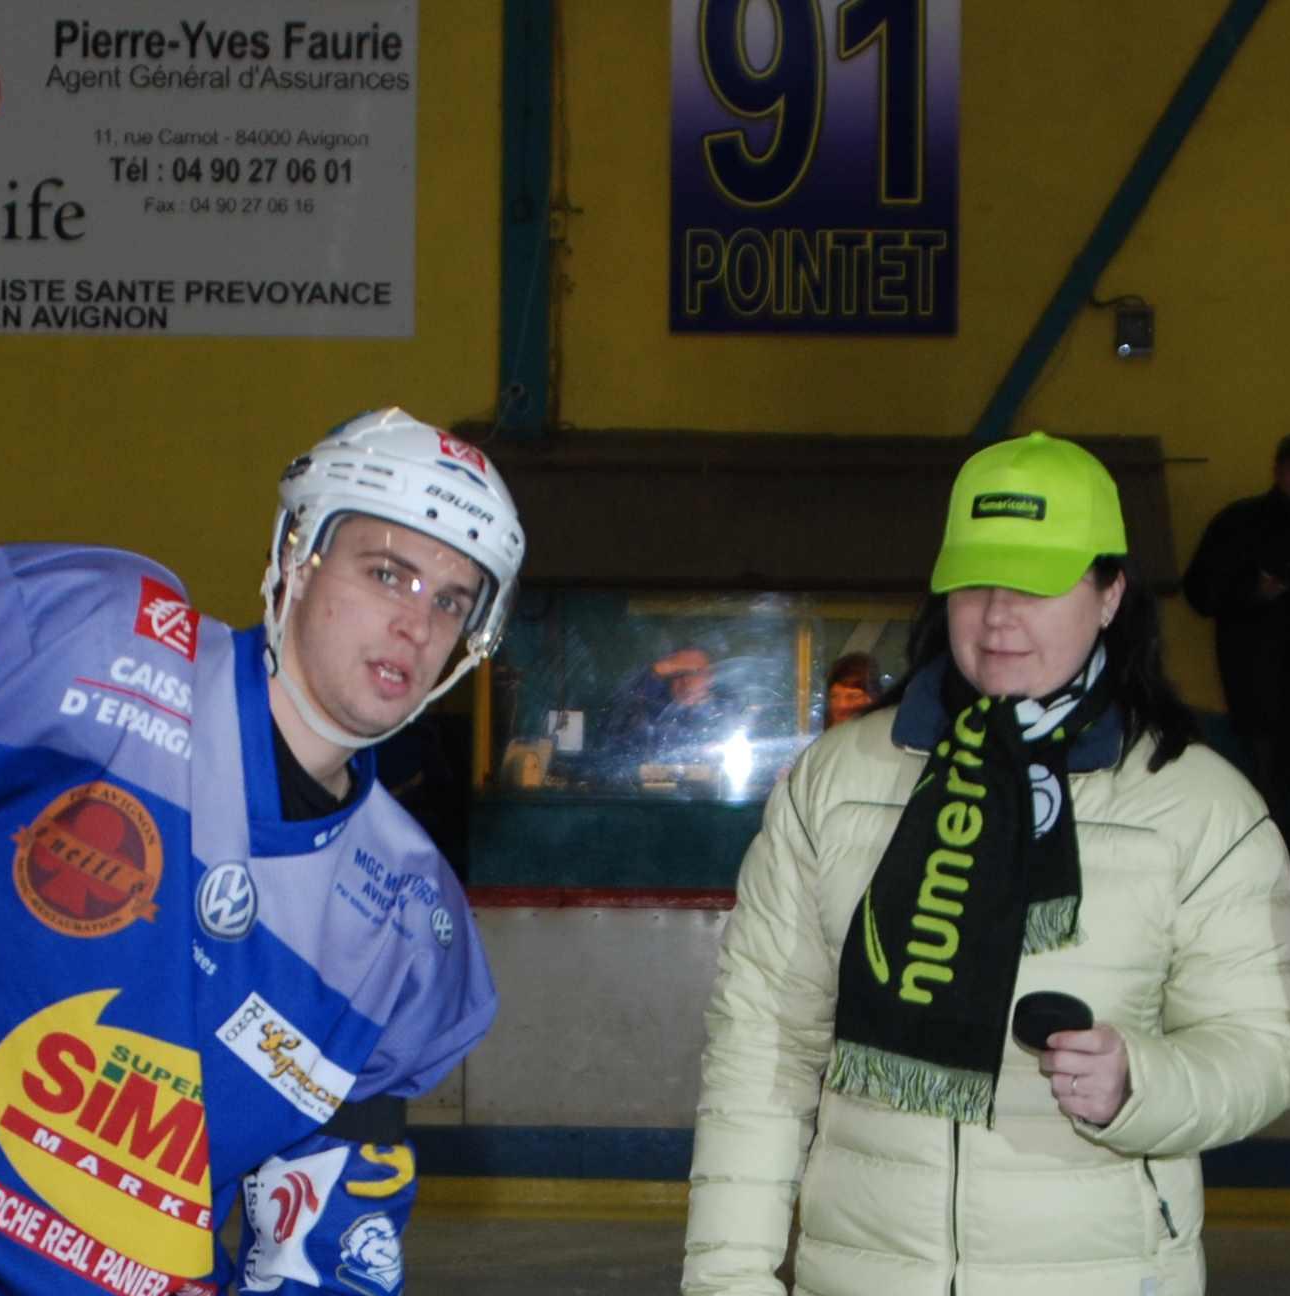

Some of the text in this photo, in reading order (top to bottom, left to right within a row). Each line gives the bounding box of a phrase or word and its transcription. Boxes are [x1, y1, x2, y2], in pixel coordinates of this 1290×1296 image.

[54, 19, 403, 61] Pierre-Yves Faurie
[45, 63, 411, 94] Agent Général d'Assurances
[698, 0, 926, 208] 91
[124, 131, 154, 146] rue
[235, 129, 291, 147] 84000
[297, 128, 370, 151] Avignon
[172, 158, 204, 184] 04
[210, 158, 241, 184] 90
[249, 158, 278, 184] 27
[286, 158, 317, 184] 06
[324, 158, 353, 184] 01
[190, 197, 214, 214] 04
[216, 197, 238, 214] 90
[241, 197, 263, 214] 27
[685, 227, 948, 317] POINTET
[75, 279, 175, 304] SANTE
[185, 280, 393, 307] PREVOYANCE
[30, 305, 168, 329] AVIGNON
[110, 656, 192, 714] CAISS
[58, 687, 192, 760] D'EPARG
[354, 848, 385, 882] MGC
[38, 1220, 95, 1274] REAL
